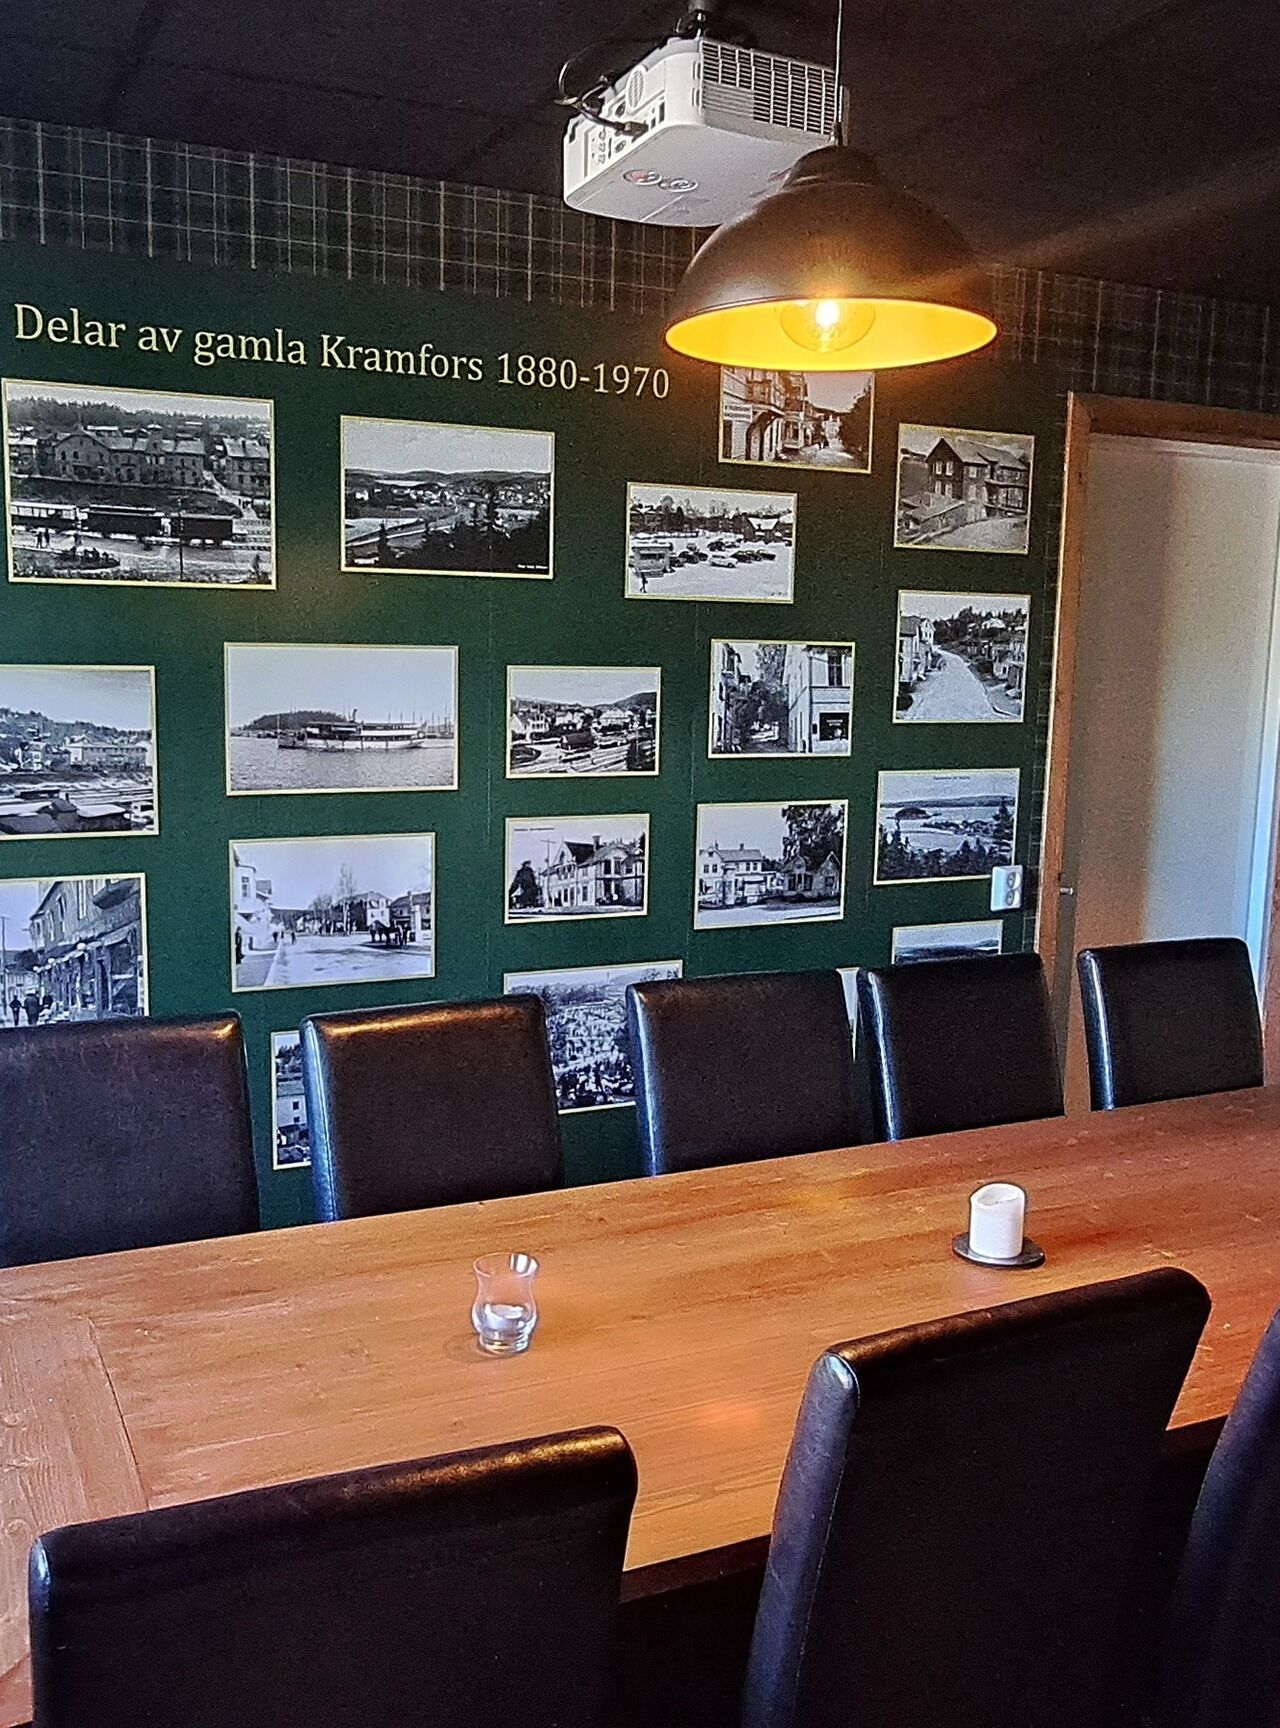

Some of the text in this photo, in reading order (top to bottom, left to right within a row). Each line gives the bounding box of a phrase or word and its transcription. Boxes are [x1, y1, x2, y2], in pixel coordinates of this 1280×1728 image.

[14, 303, 670, 399] Delar av gamla Kramfors 1880-1970
